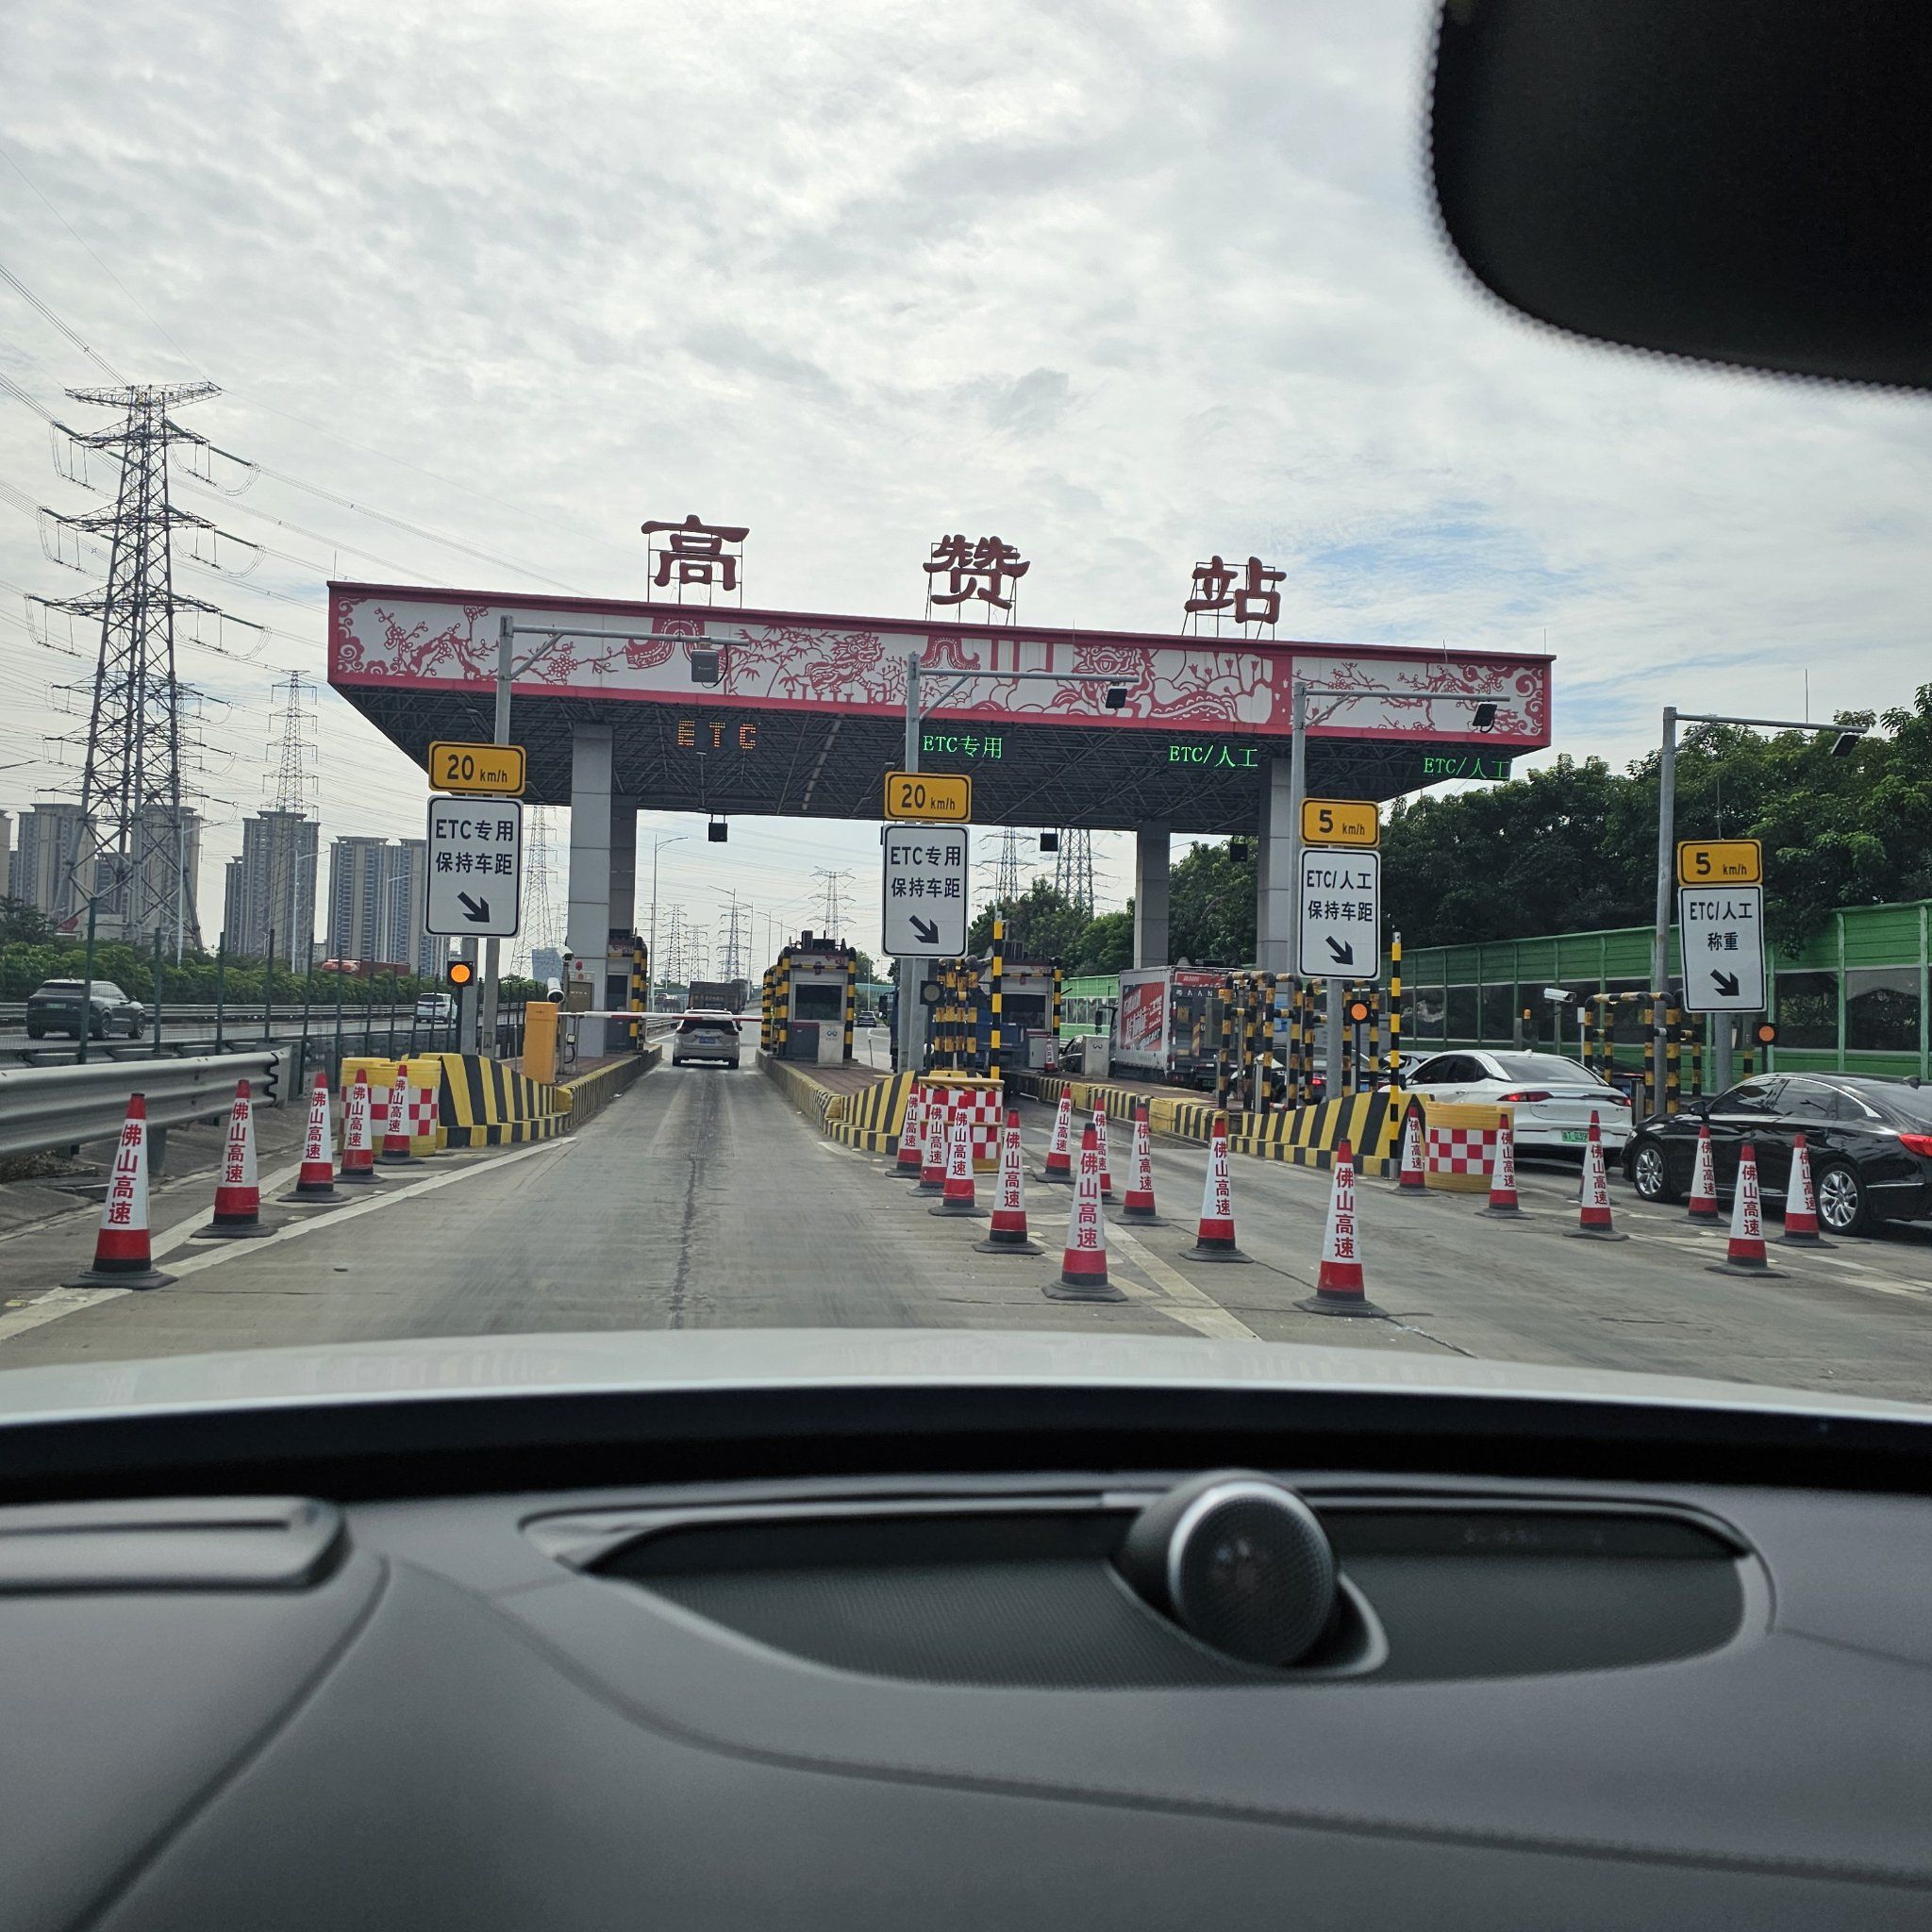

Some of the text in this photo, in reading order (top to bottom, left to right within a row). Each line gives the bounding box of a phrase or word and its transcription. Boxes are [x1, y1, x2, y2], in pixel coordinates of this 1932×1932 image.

[641, 513, 1288, 625] 高赞站
[677, 720, 757, 749] ETC
[923, 735, 1003, 759] ETC专用
[1169, 745, 1258, 768] ETC/人工
[447, 754, 508, 783] 20 km/h
[1423, 758, 1510, 780] ETC/人工
[901, 784, 956, 810] 20 km/h
[1319, 808, 1365, 836] 5 km/h
[436, 819, 514, 842] ETC专用
[436, 851, 513, 875] 保持车距
[891, 846, 961, 867] ETC专用
[1307, 870, 1372, 890] ETC/人工
[1695, 852, 1747, 875] 5 km/h
[891, 877, 960, 898] 保持车距
[1307, 900, 1374, 923] 保持车距
[1690, 901, 1753, 921] ETC/人工
[1707, 932, 1739, 952] 称重
[306, 1091, 325, 1159] 佛山高速
[348, 1086, 365, 1146] 佛山高速
[389, 1079, 405, 1132] 佛山高速
[906, 1096, 919, 1147] 佛山高速
[1057, 1101, 1070, 1152] 佛山高速
[225, 1102, 249, 1183] 佛山高速
[930, 1107, 942, 1164] 佛山高速
[953, 1112, 968, 1176] 佛山高速
[1138, 1125, 1153, 1191] 佛山高速
[1410, 1120, 1423, 1169] 佛山高速
[1501, 1132, 1515, 1188] 佛山高速
[108, 1124, 142, 1224] 佛山高速
[1004, 1131, 1021, 1208] 佛山高速
[1214, 1141, 1230, 1216] 佛山高速
[1591, 1144, 1607, 1206] 佛山高速
[1702, 1141, 1715, 1195] 佛山高速
[1077, 1152, 1098, 1249] 佛山高速
[1334, 1167, 1355, 1259] 佛山高速
[1741, 1164, 1760, 1237] 佛山高速
